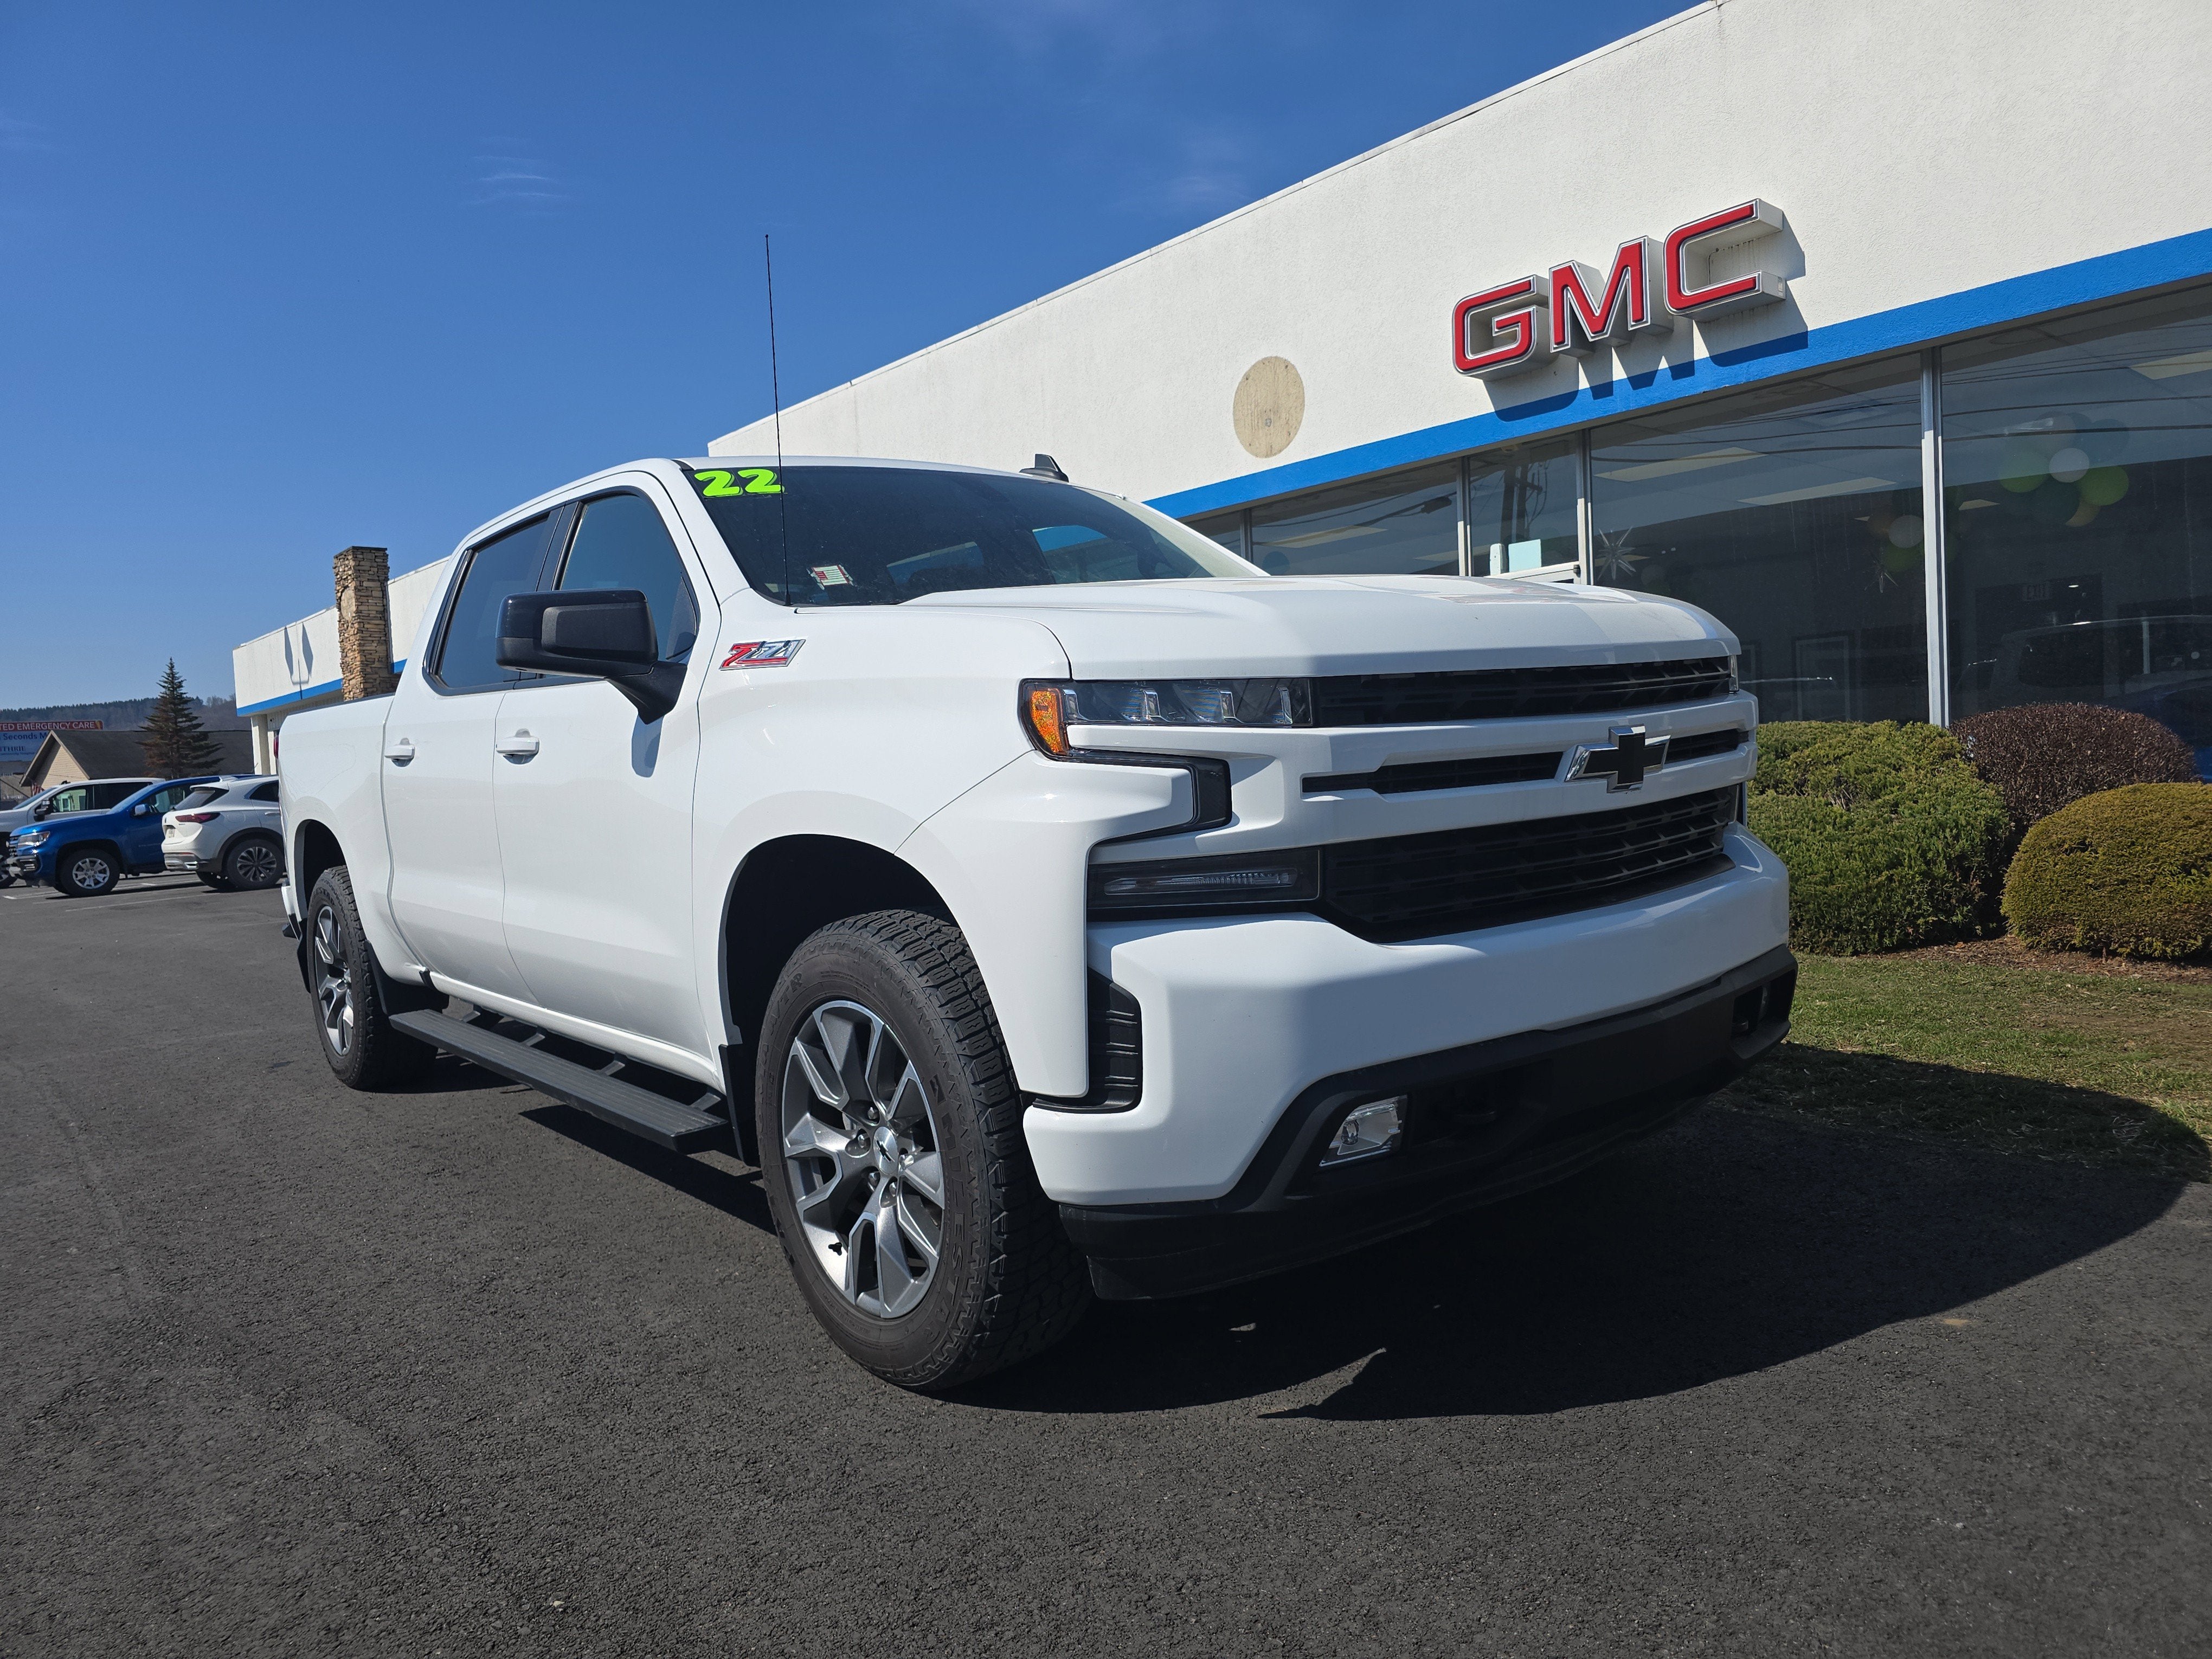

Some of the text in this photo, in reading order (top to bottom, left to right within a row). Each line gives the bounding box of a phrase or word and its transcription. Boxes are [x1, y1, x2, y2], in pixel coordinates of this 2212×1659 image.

[1452, 198, 1784, 376] GMC
[695, 468, 785, 497] 22
[719, 639, 806, 671] Z71
[3, 732, 37, 741] Seconds
[17, 722, 70, 730] EMERGENCY
[923, 1113, 965, 1346] MILESTAR
